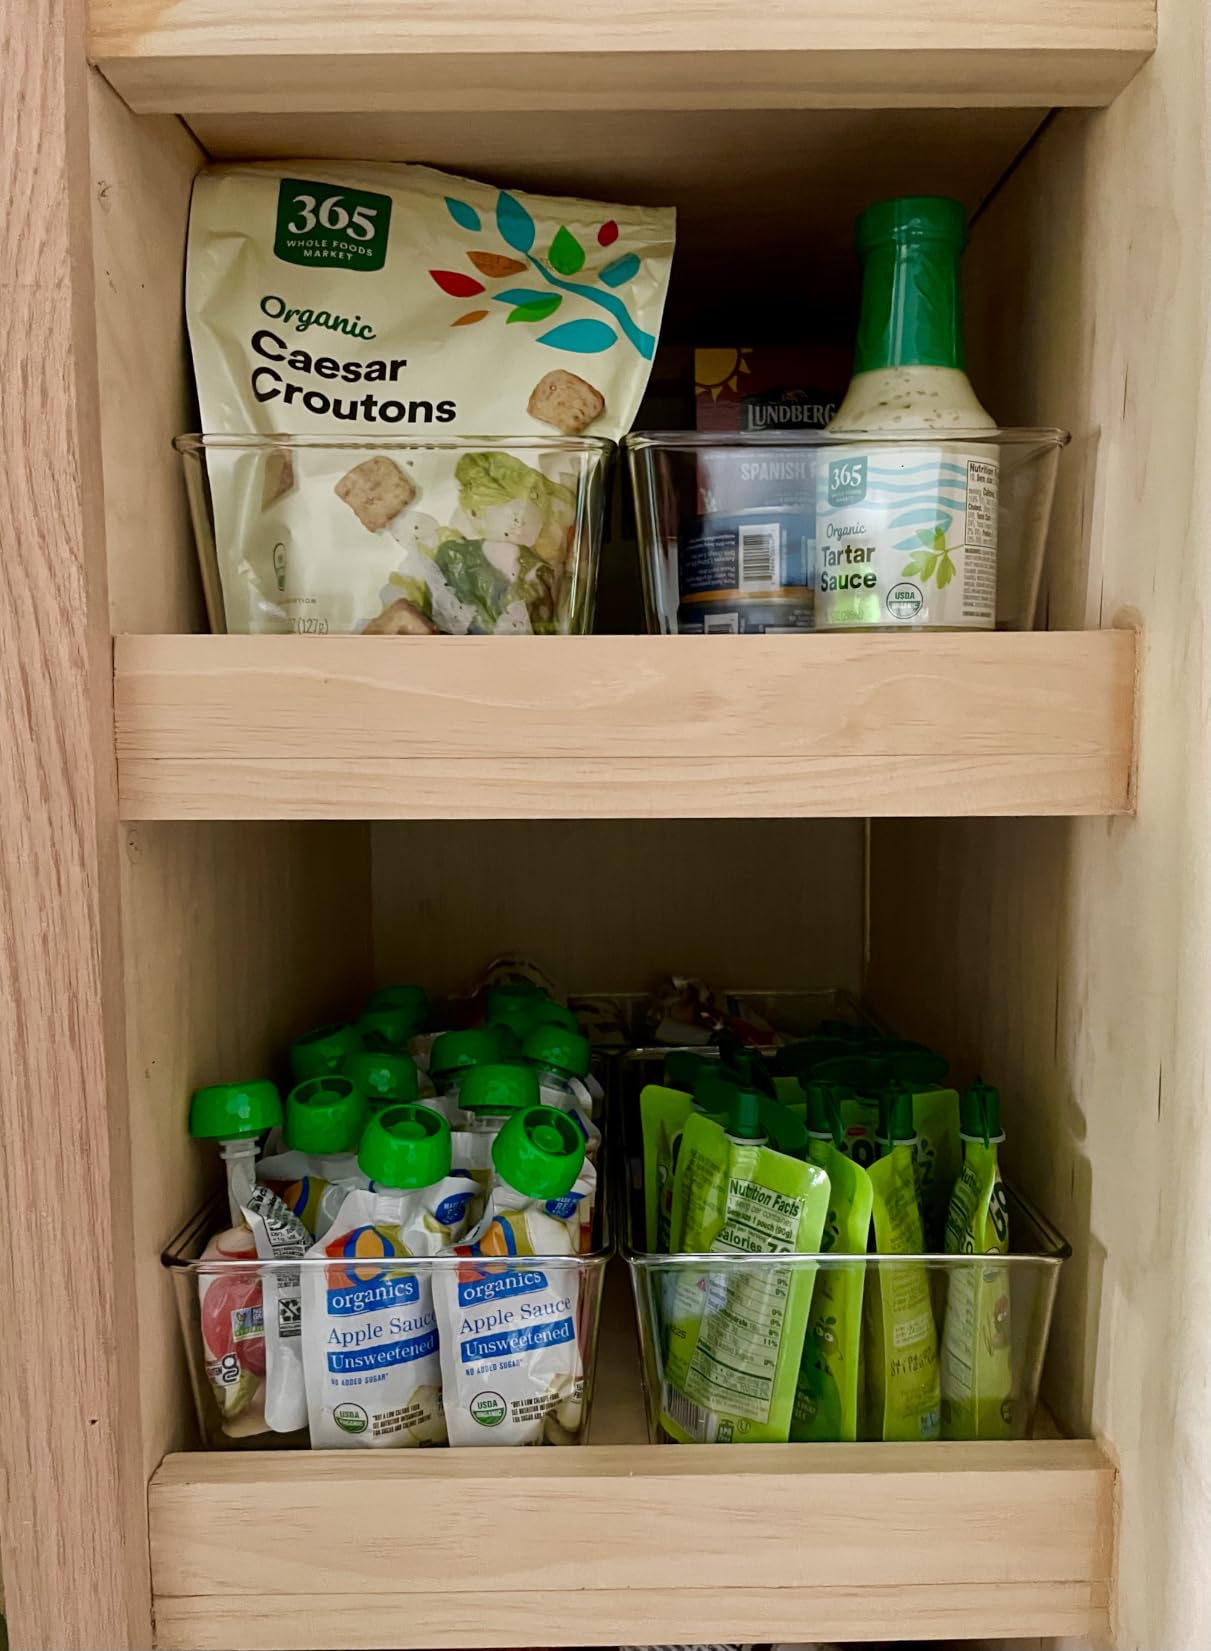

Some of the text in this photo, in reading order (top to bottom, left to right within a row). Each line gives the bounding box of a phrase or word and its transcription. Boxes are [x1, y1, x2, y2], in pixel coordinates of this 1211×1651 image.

[288, 195, 378, 241] 365
[286, 240, 374, 257] WHOLE FOODS
[303, 249, 354, 261] MARKET
[260, 295, 377, 341] Organic
[251, 329, 408, 383] Caesar
[251, 366, 457, 424] Croutons
[746, 403, 836, 431] LUNDBERG
[740, 461, 804, 481] SPANISH
[831, 463, 863, 490] 365
[826, 521, 867, 542] Organic
[821, 544, 876, 567] Tartar
[820, 571, 878, 593] Sauce
[894, 591, 916, 600] USDA
[730, 1179, 800, 1217] Nutrition Facts
[718, 1229, 762, 1252] alories
[757, 1219, 774, 1232] pouch
[775, 1224, 793, 1239] (90g)
[332, 1279, 414, 1311] organics
[463, 1272, 542, 1300] organics
[460, 1296, 572, 1335] Apple Sauce
[327, 1323, 383, 1347] Apple
[465, 1322, 570, 1357] Unsweetened
[331, 1335, 434, 1369] Unsweetened
[465, 1367, 475, 1376] NO
[476, 1364, 498, 1374] ADDED
[341, 1378, 363, 1386] ADDED
[340, 1410, 360, 1419] USDA
[477, 1399, 498, 1410] USDA
